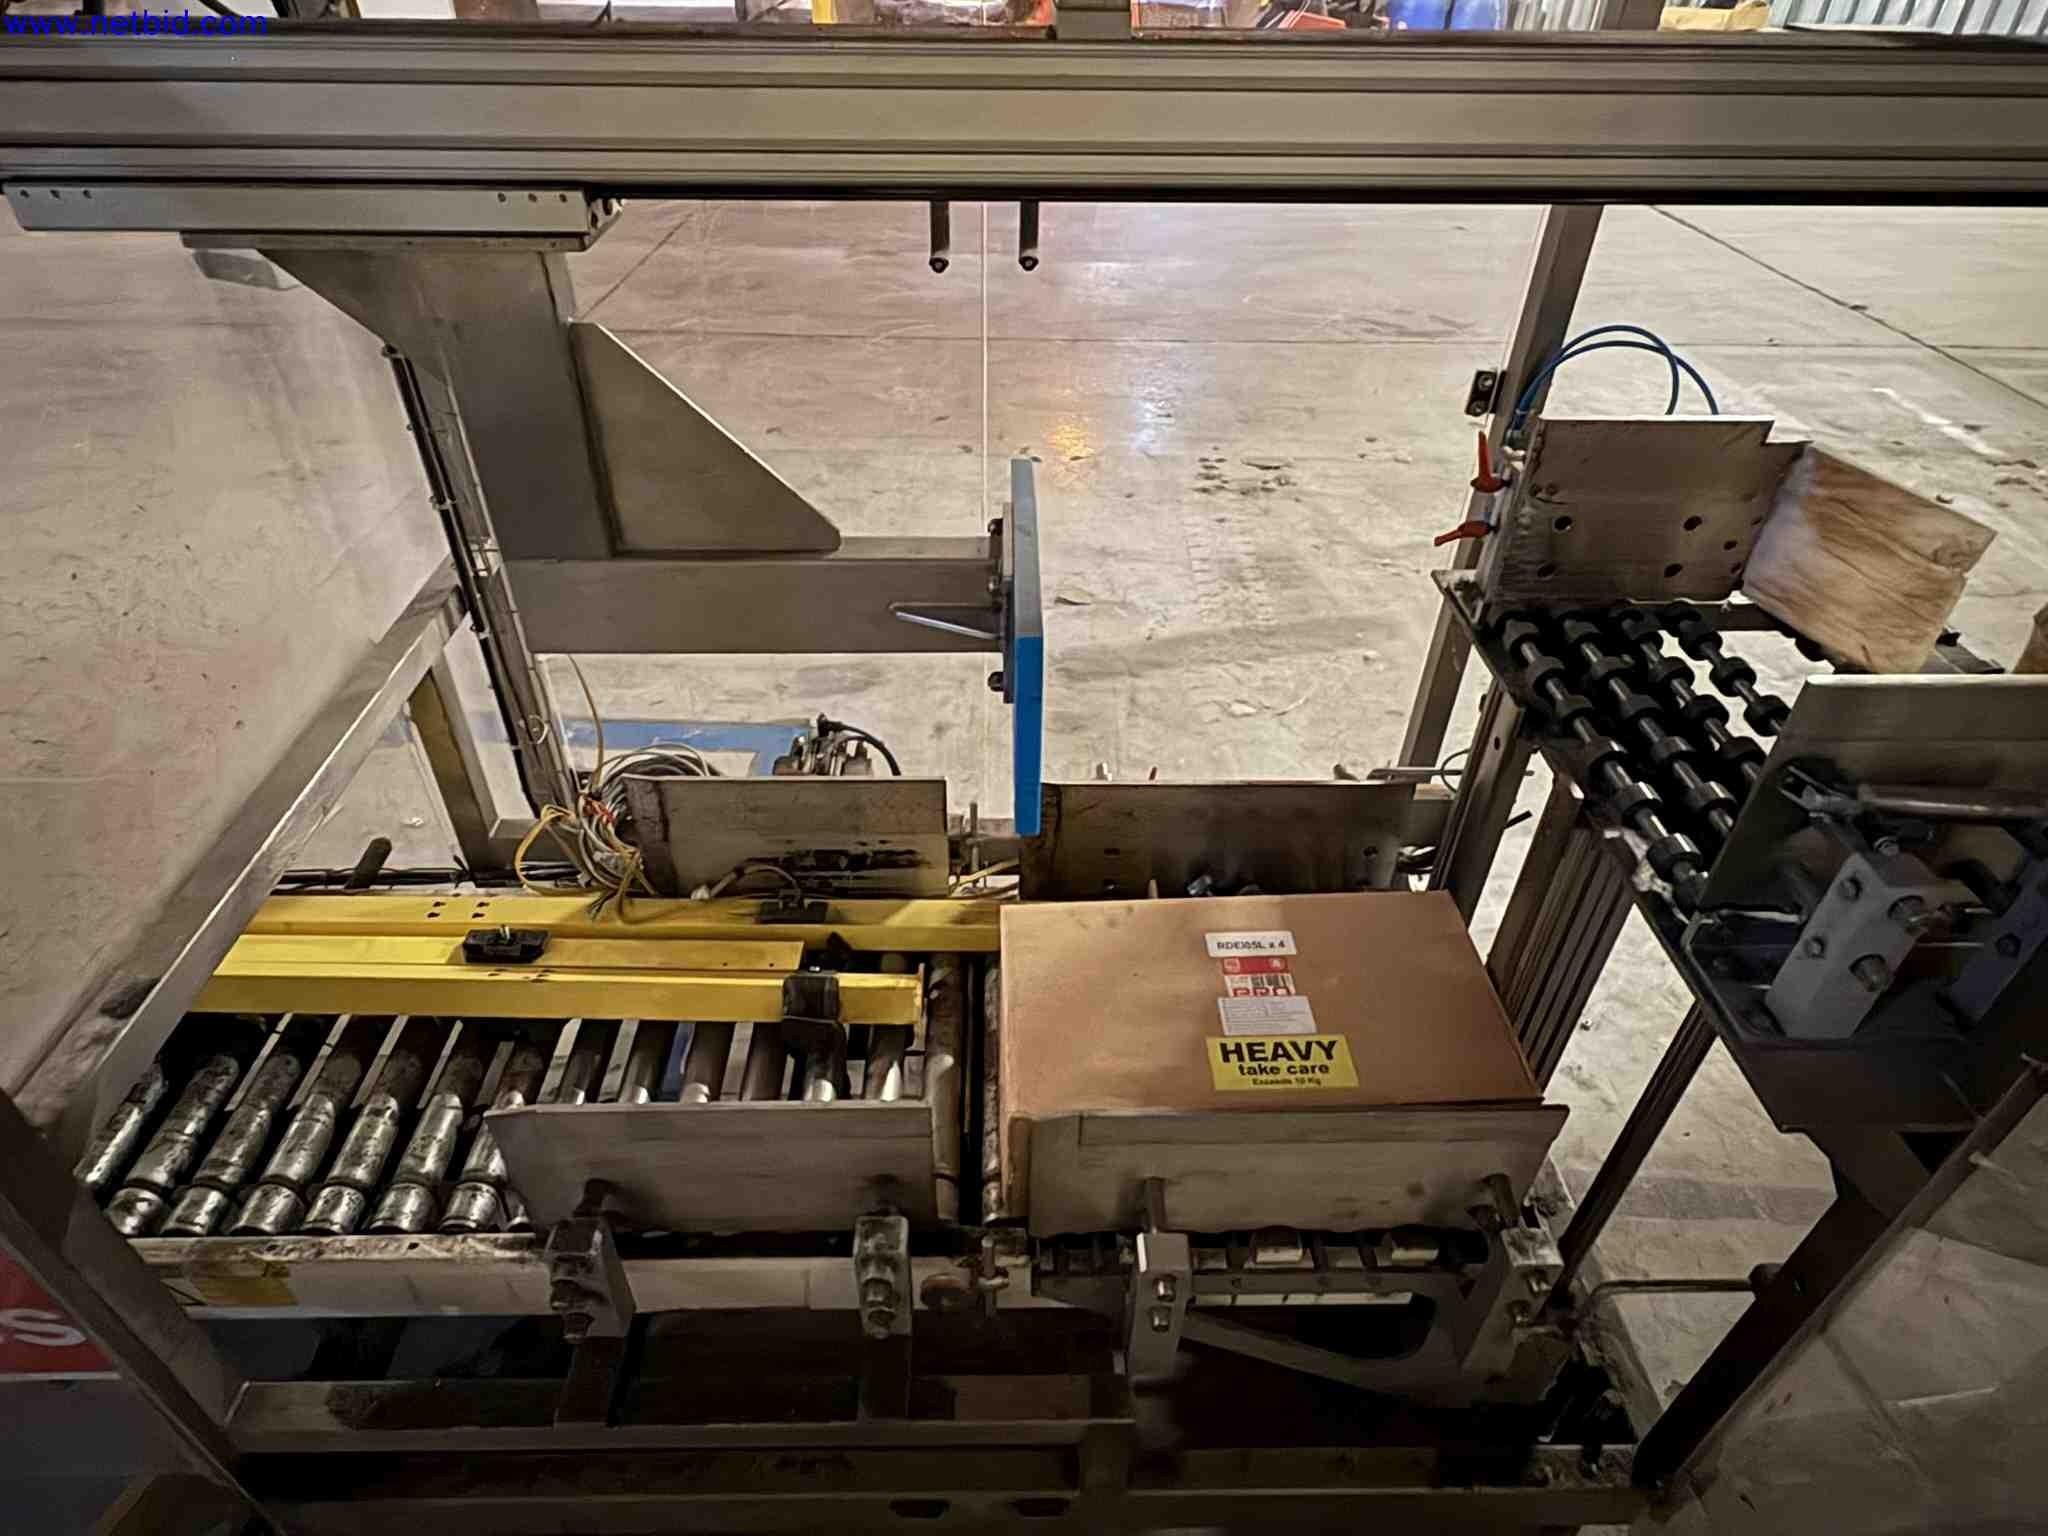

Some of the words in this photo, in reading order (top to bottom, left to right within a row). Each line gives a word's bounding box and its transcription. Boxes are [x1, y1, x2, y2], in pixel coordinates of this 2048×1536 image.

[1219, 1040, 1338, 1063] HEAVY
[1238, 1063, 1281, 1076] take
[1286, 1064, 1330, 1075] care
[0, 1308, 87, 1347] S
